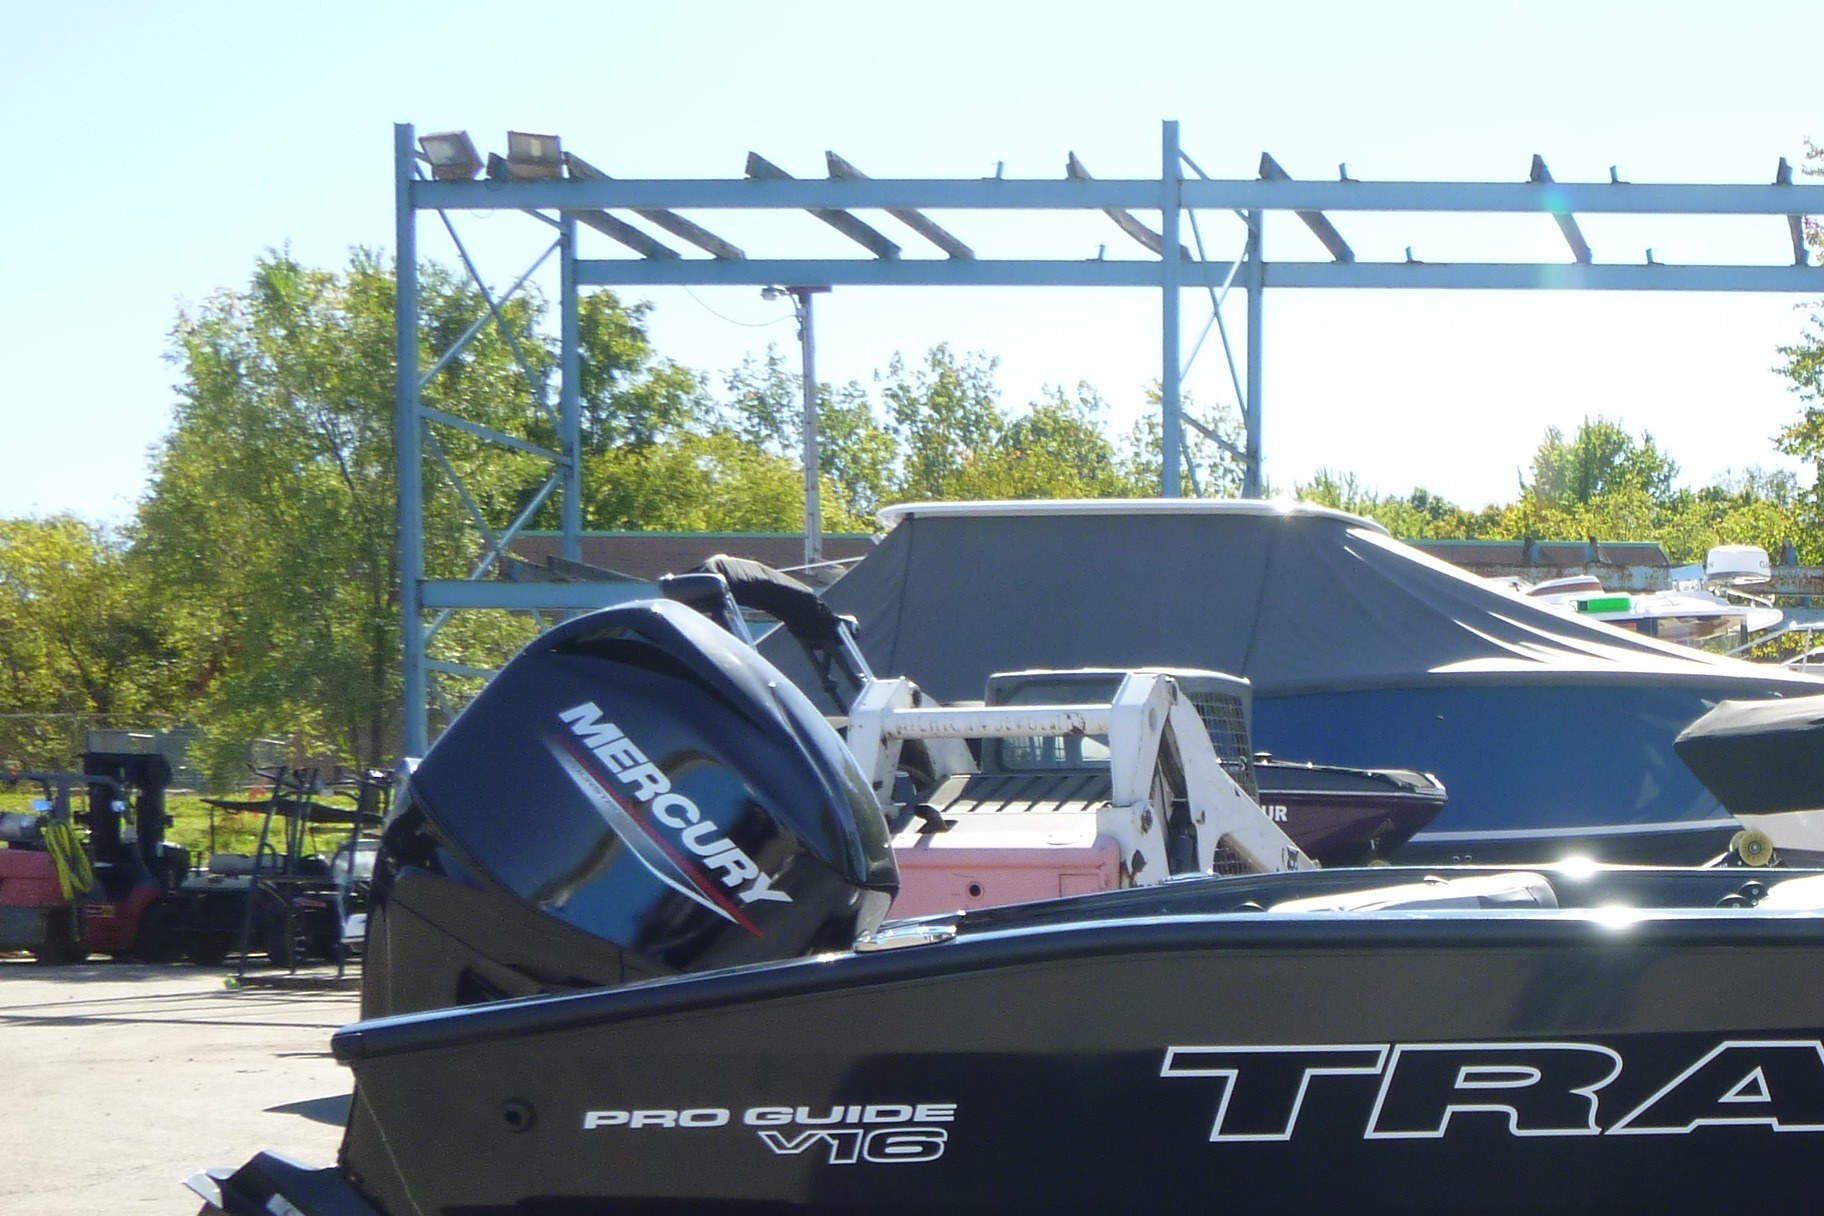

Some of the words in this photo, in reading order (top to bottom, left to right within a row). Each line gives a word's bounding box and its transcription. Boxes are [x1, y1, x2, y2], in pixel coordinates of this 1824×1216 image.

[558, 701, 793, 904] MERCURY
[583, 1108, 730, 1129] PRO
[742, 1104, 957, 1125] GUIDE
[757, 1128, 948, 1164] V16
